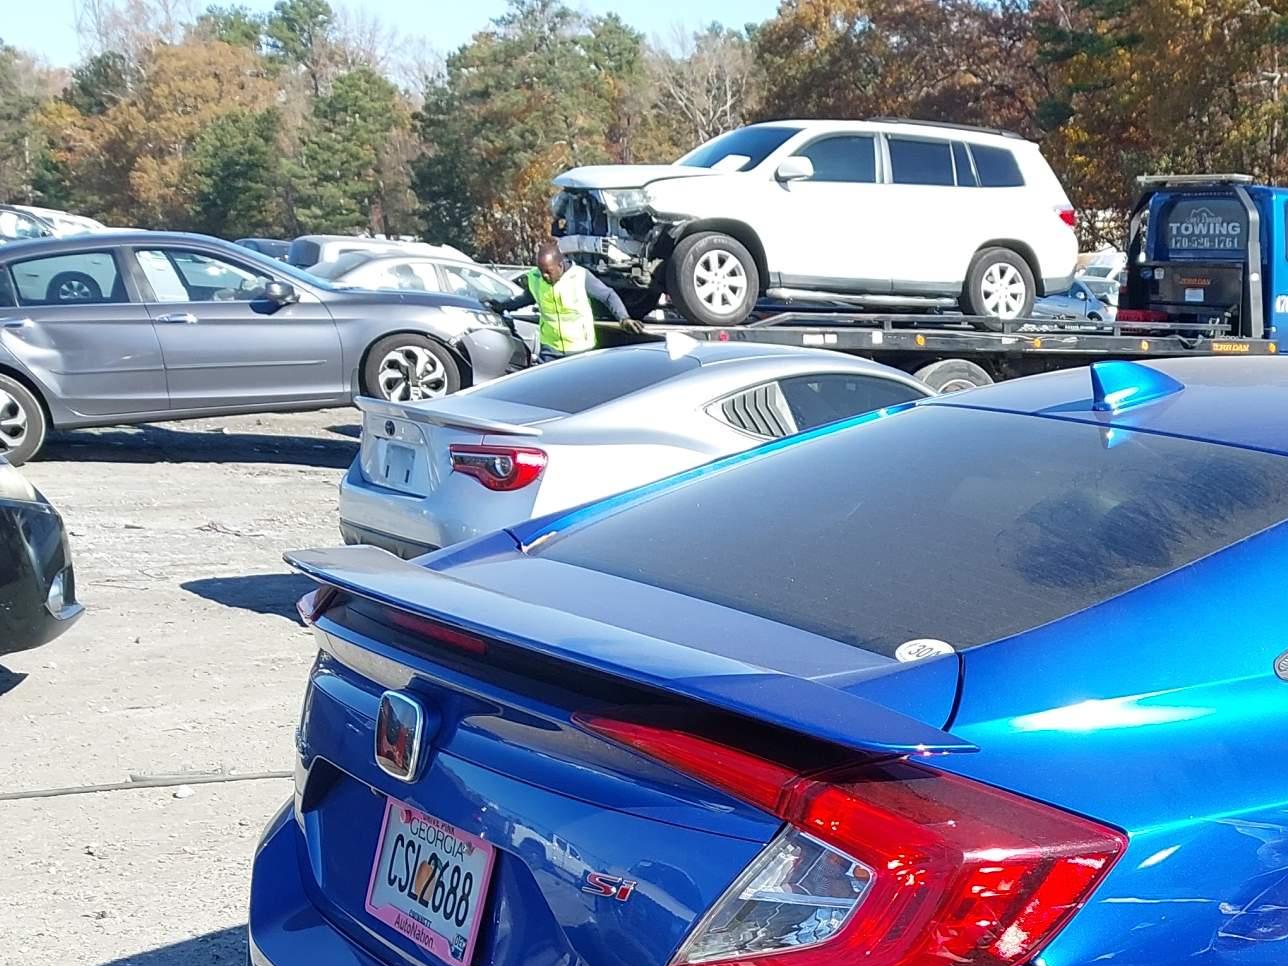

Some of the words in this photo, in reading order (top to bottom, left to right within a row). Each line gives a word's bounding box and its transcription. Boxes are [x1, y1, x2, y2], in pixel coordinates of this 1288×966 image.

[1169, 222, 1241, 235] TOWING
[409, 817, 464, 862] GEORGIA
[387, 833, 473, 928] CSL2688
[581, 871, 637, 902] Si
[394, 913, 434, 949] AutoNation
